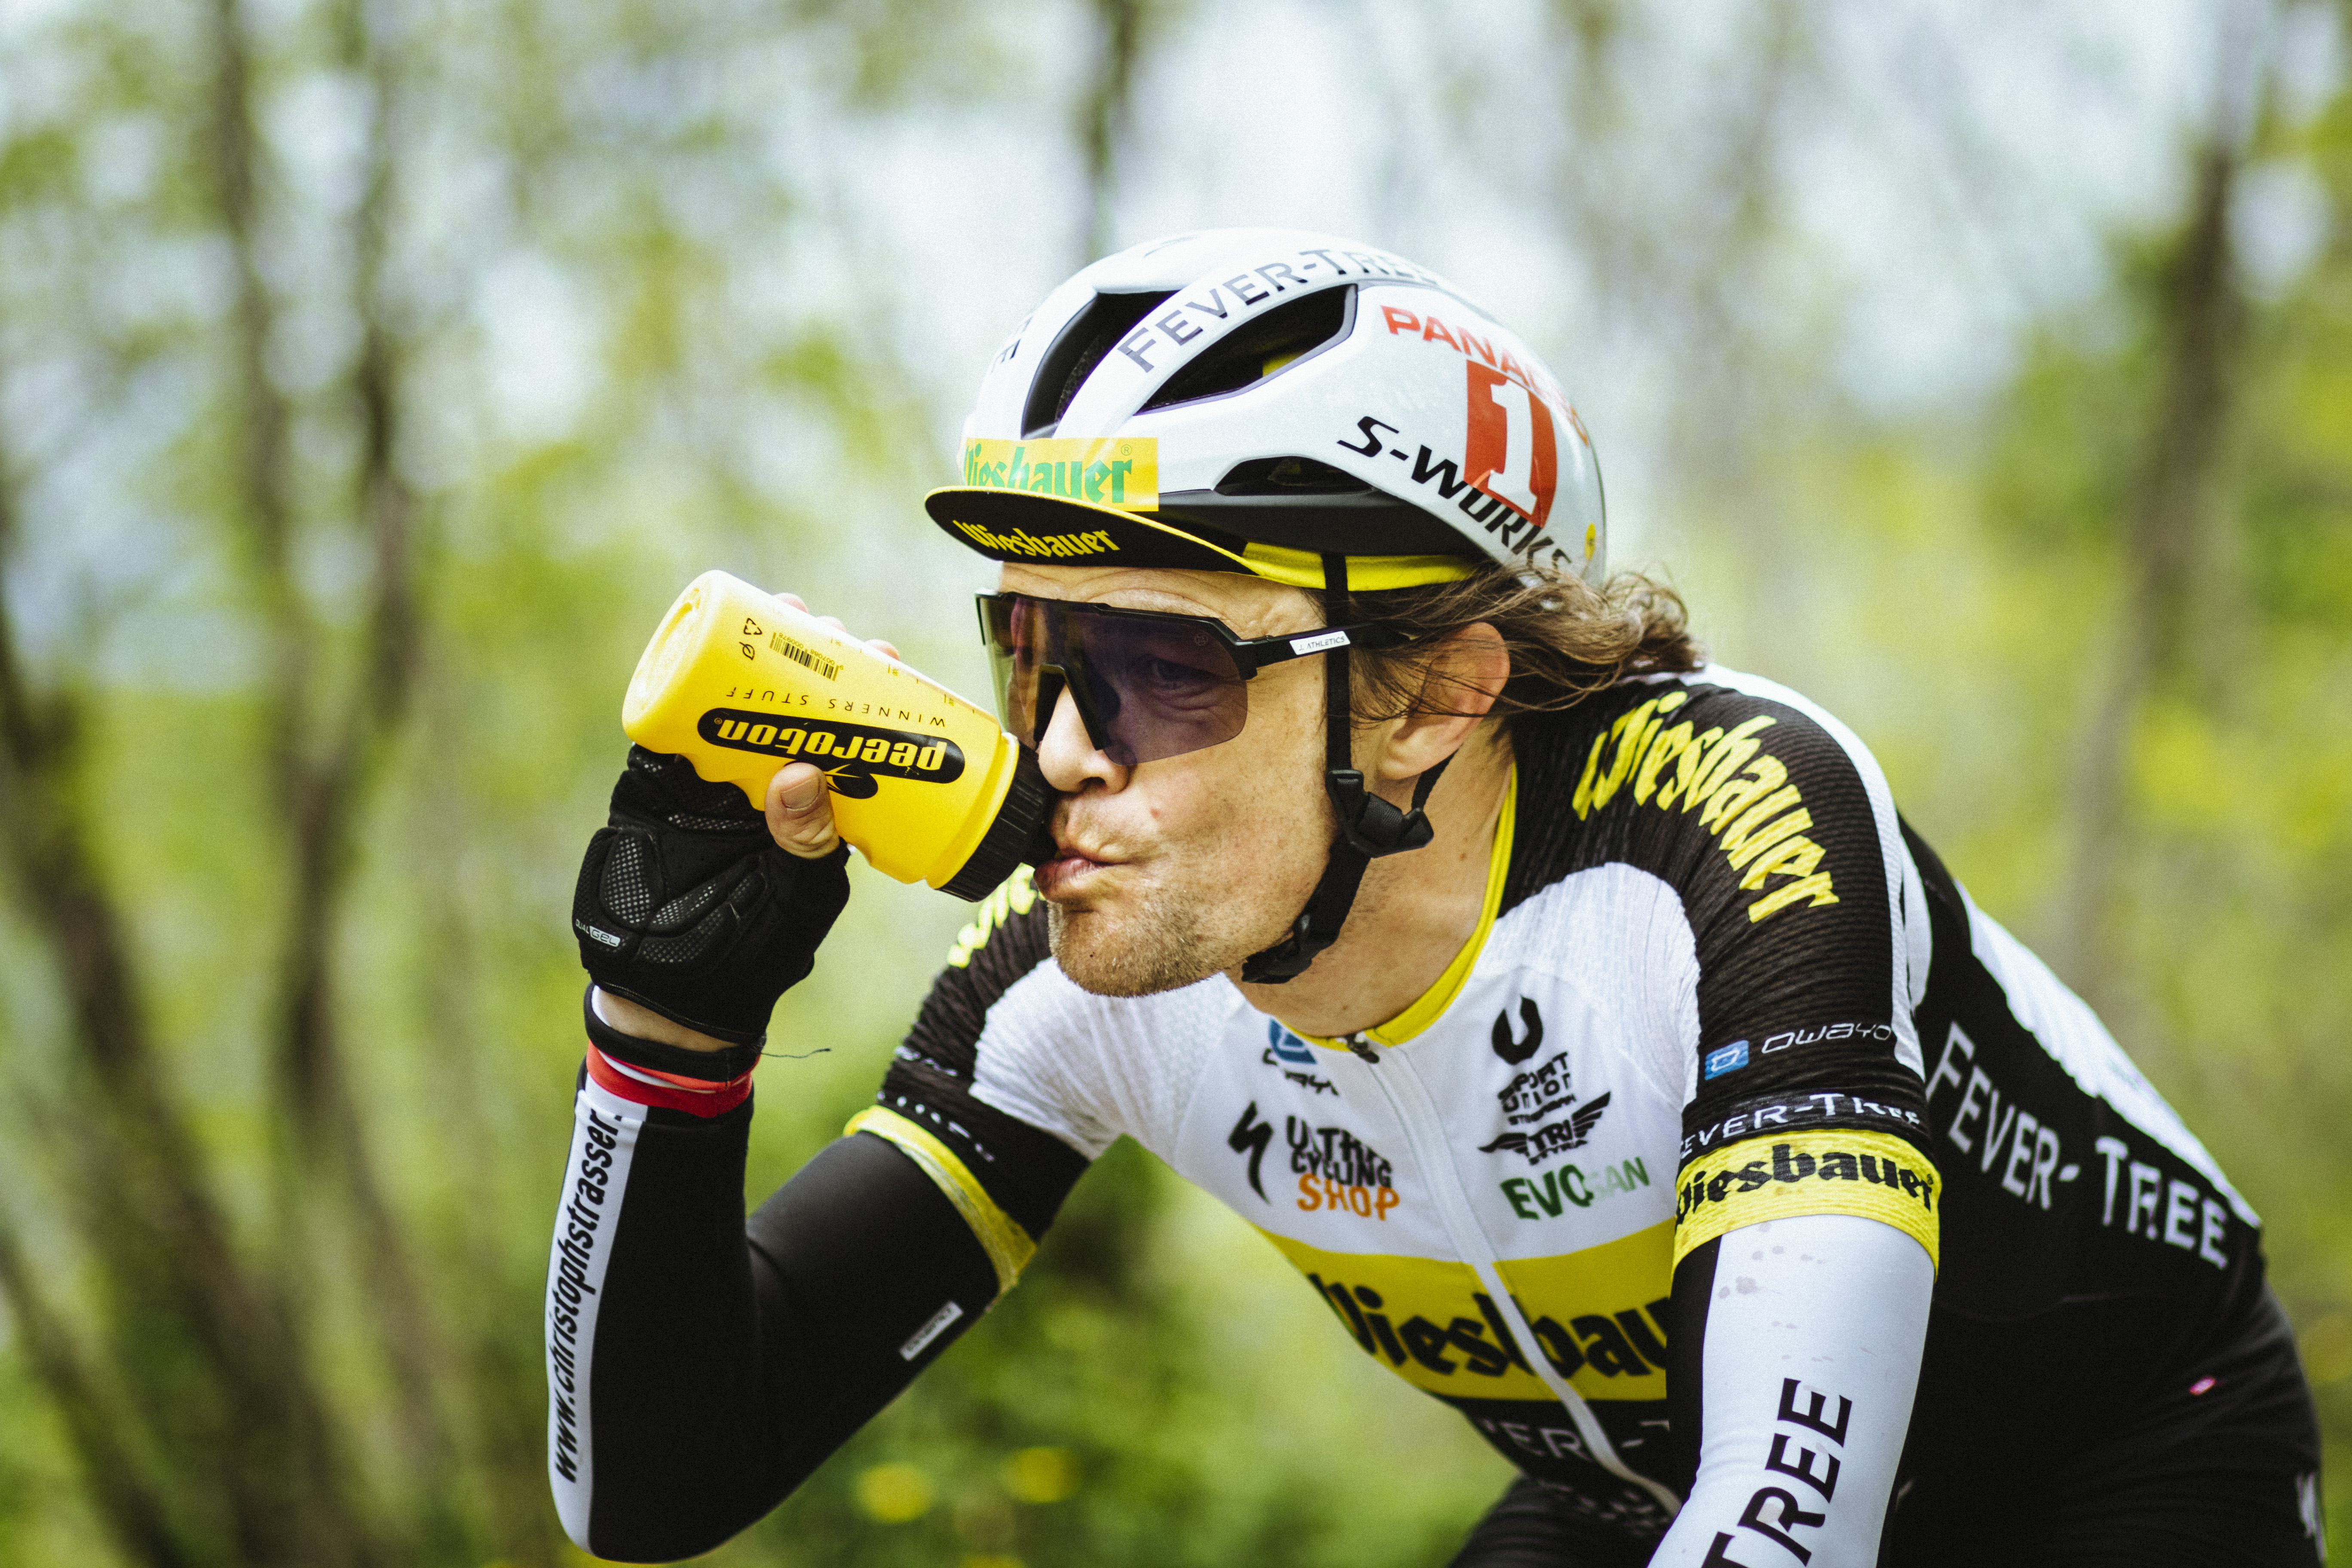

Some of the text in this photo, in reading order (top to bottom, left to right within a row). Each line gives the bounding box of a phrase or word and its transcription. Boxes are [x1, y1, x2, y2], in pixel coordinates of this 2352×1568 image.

[779, 632, 804, 650] 000978
[810, 649, 836, 666] 007088
[1306, 636, 1345, 649] ATHLETICS
[726, 686, 945, 727] WINNERS STUFF
[717, 718, 949, 771] peeroton
[1528, 1119, 1573, 1152] TRI
[1681, 1093, 1920, 1160] EVER-TREE
[1297, 1173, 1400, 1221] SHOP
